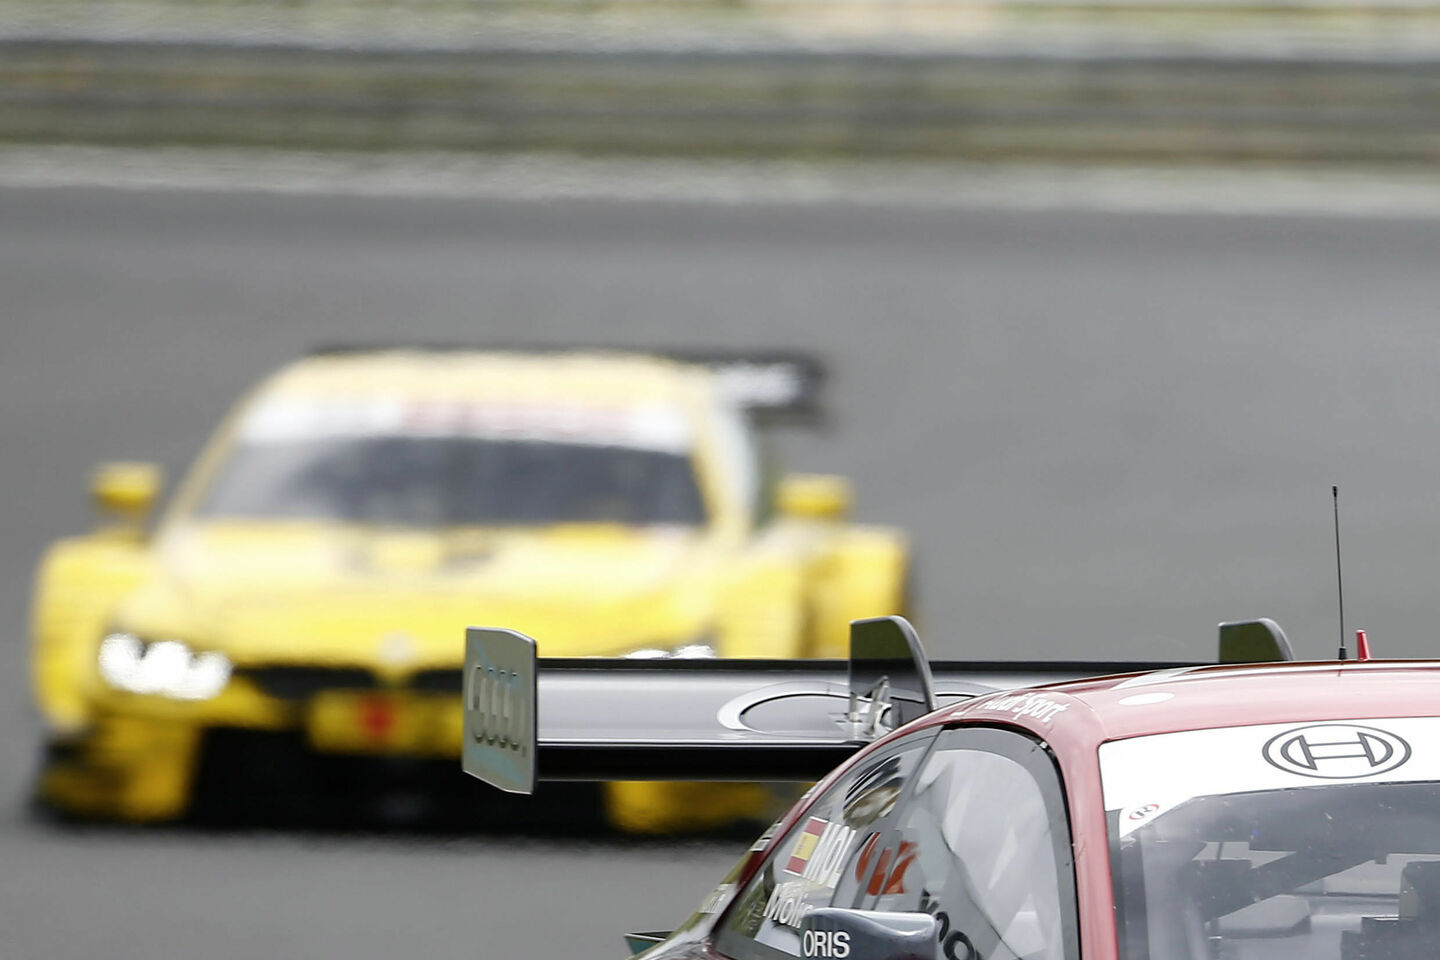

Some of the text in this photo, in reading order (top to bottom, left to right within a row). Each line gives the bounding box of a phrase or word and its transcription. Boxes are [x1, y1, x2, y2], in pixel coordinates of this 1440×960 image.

[1012, 692, 1070, 723] Sport
[762, 883, 814, 929] Molin
[803, 930, 850, 959] ORIS
